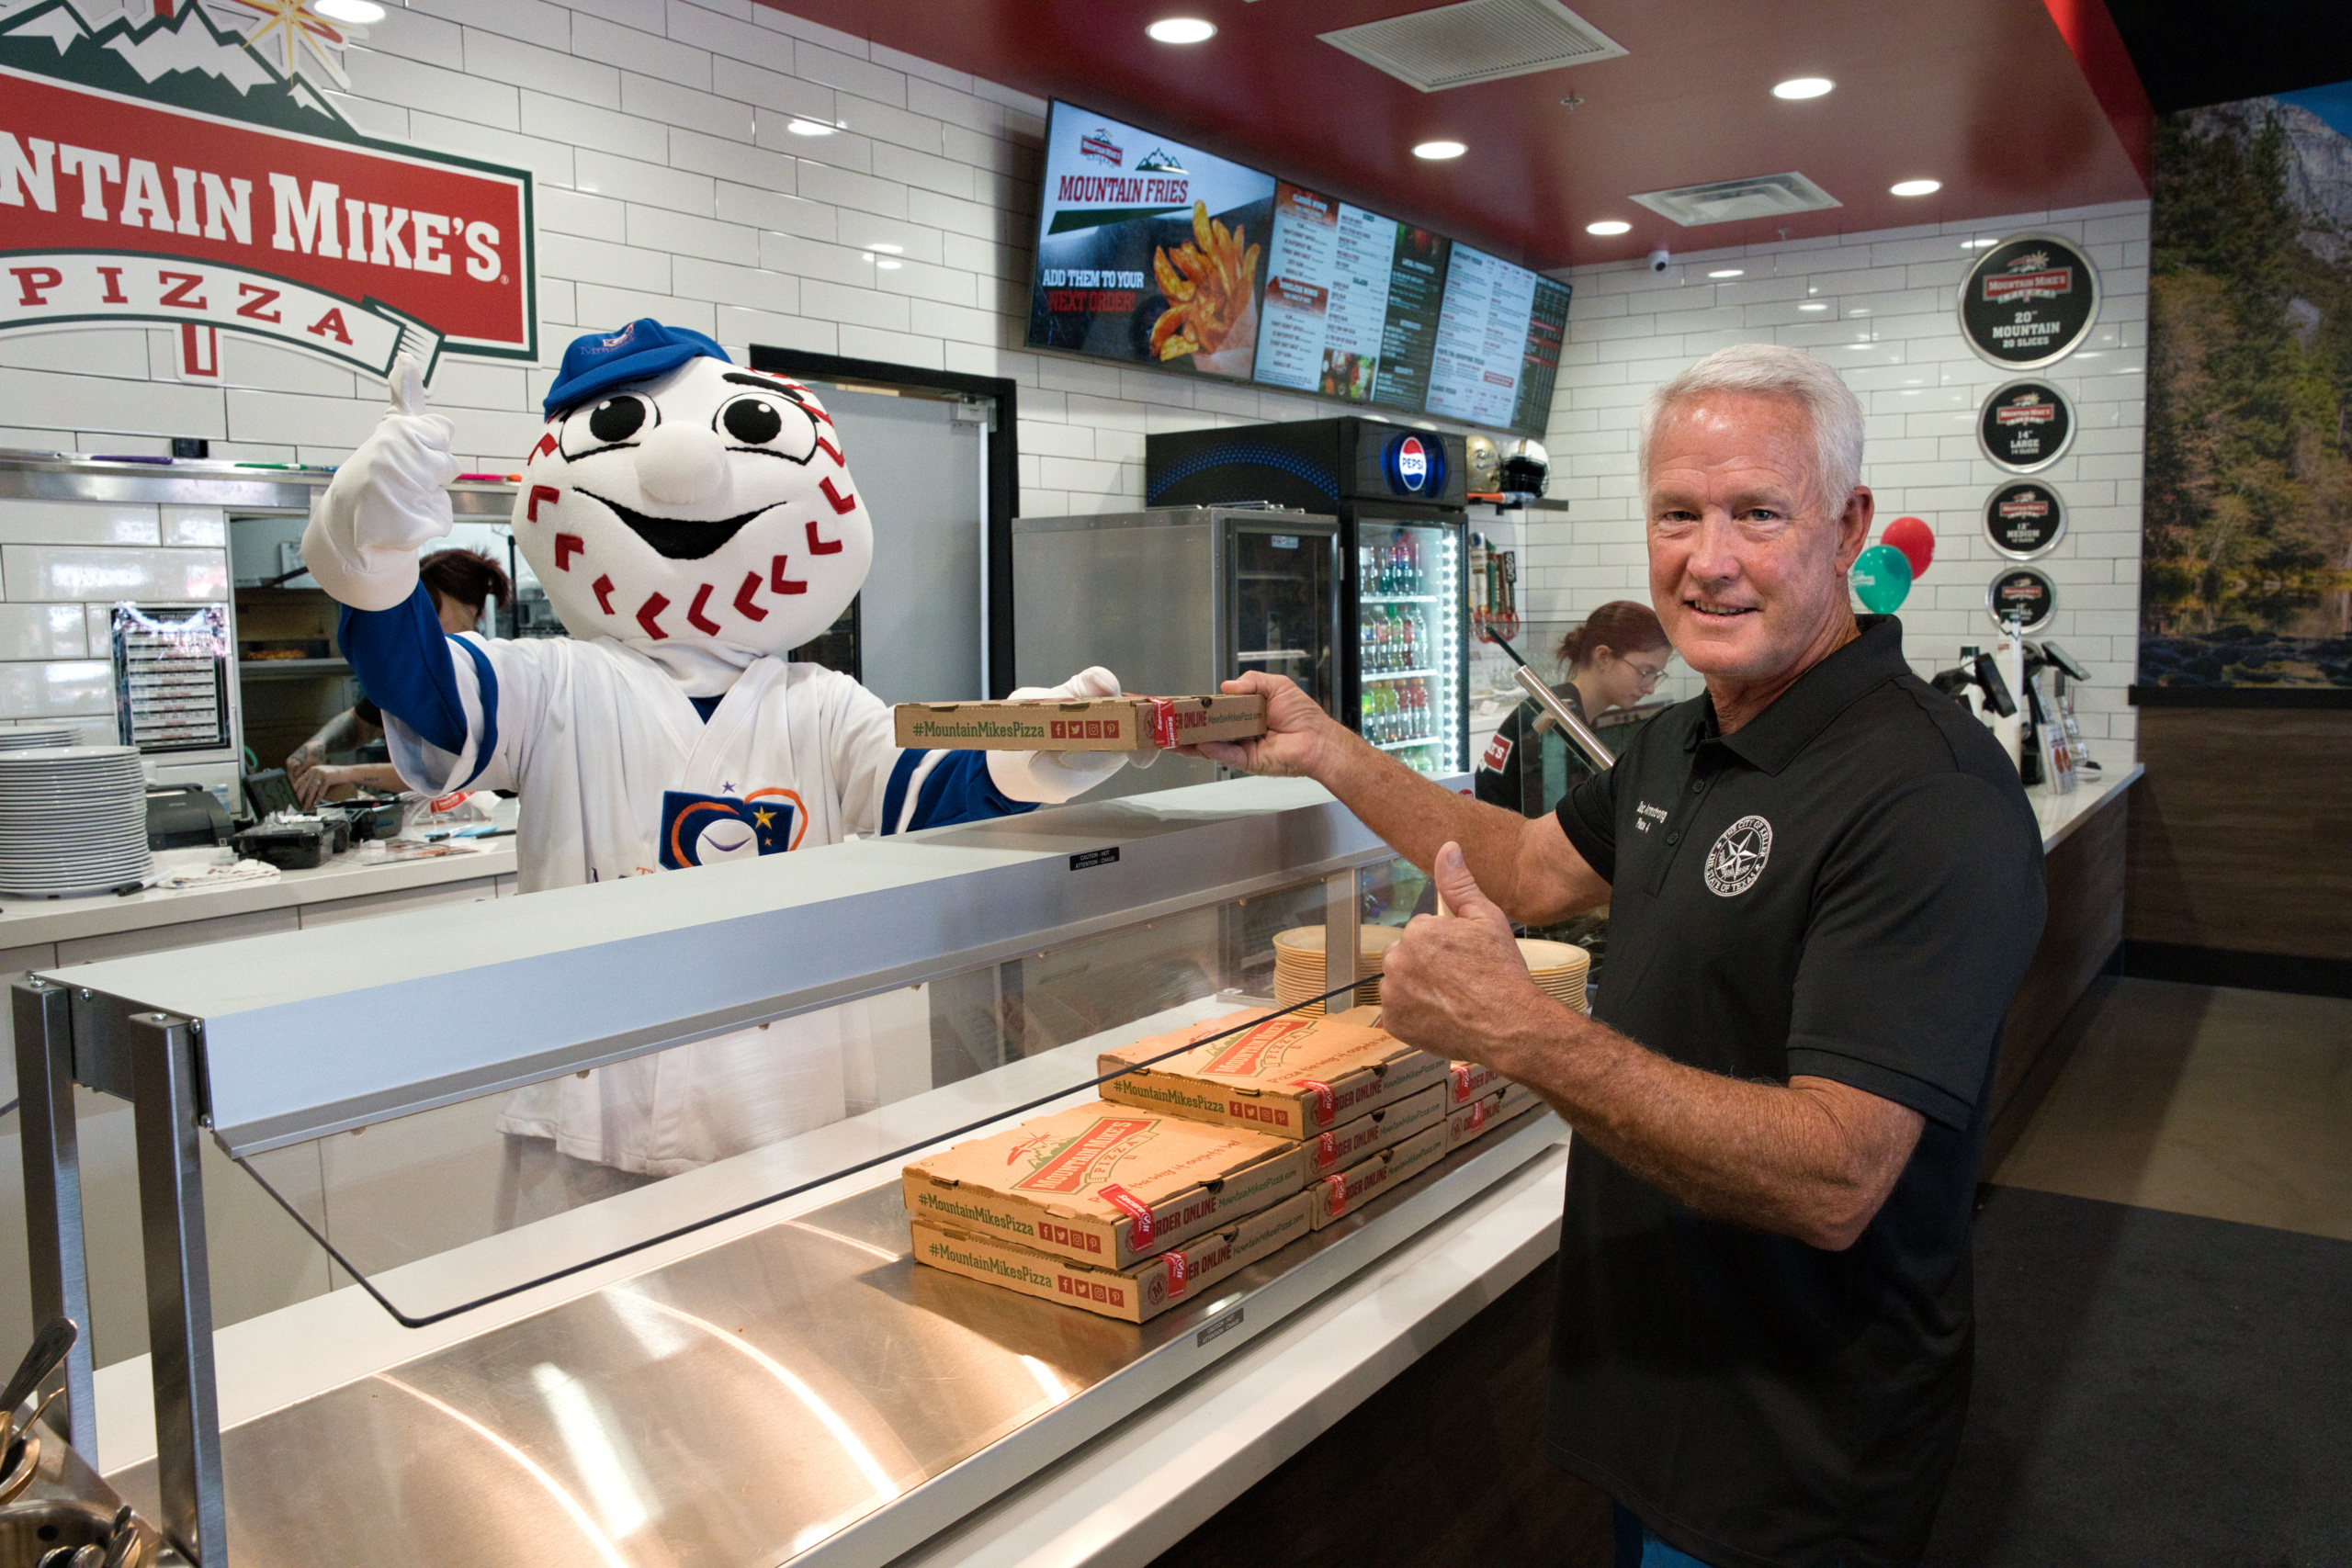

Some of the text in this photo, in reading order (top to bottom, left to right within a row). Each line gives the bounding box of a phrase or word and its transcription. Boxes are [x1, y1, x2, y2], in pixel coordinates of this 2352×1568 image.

[1058, 175, 1188, 203] MOUNTAIN FRIES
[269, 172, 502, 282] MIKE'S
[1042, 269, 1145, 288] ADD THEM TO YOUR
[8, 266, 354, 345] PIZZA
[1047, 290, 1087, 312] NEXT
[1992, 321, 2061, 338] MOUNTAIN
[2010, 438, 2040, 448] LARGE
[1402, 457, 1424, 470] PEPSI
[912, 720, 1045, 738] #MountainMikesPizza
[1184, 710, 1206, 728] ONLINE
[1738, 819, 1755, 829] CITY
[1758, 828, 1770, 858] KELLER
[1075, 859, 1098, 869] ATTENTION
[1080, 852, 1099, 861] CAUTION
[1707, 869, 1722, 889] STATE
[1720, 884, 1730, 892] OF
[1731, 872, 1756, 891] TEXAS
[1215, 1040, 1270, 1073] MOUNTAIN
[1267, 1034, 1301, 1059] PIZZA
[1266, 1070, 1302, 1084] Pizza
[1114, 1079, 1226, 1114] #MountainMikesPizza
[1355, 1078, 1383, 1103] ONLINE
[1353, 1124, 1379, 1150] ONLINE
[1030, 1122, 1132, 1190] MOUNTAIN MIKE'S
[1093, 1141, 1139, 1173] PIZZA
[1151, 1168, 1177, 1181] way
[1185, 1148, 1226, 1166] oughta
[1364, 1166, 1388, 1190] ONLINE
[1117, 1194, 1146, 1213] Secure
[1182, 1196, 1217, 1225] ONLINE
[1217, 1169, 1297, 1209] MountainMikesPizza.com
[919, 1192, 1035, 1236] #MountainMikesPizza
[1201, 1244, 1233, 1273] ONLINE
[1233, 1213, 1305, 1256] MountainMikesPizza.com
[929, 1243, 1053, 1289] #MountainMikesPizza
